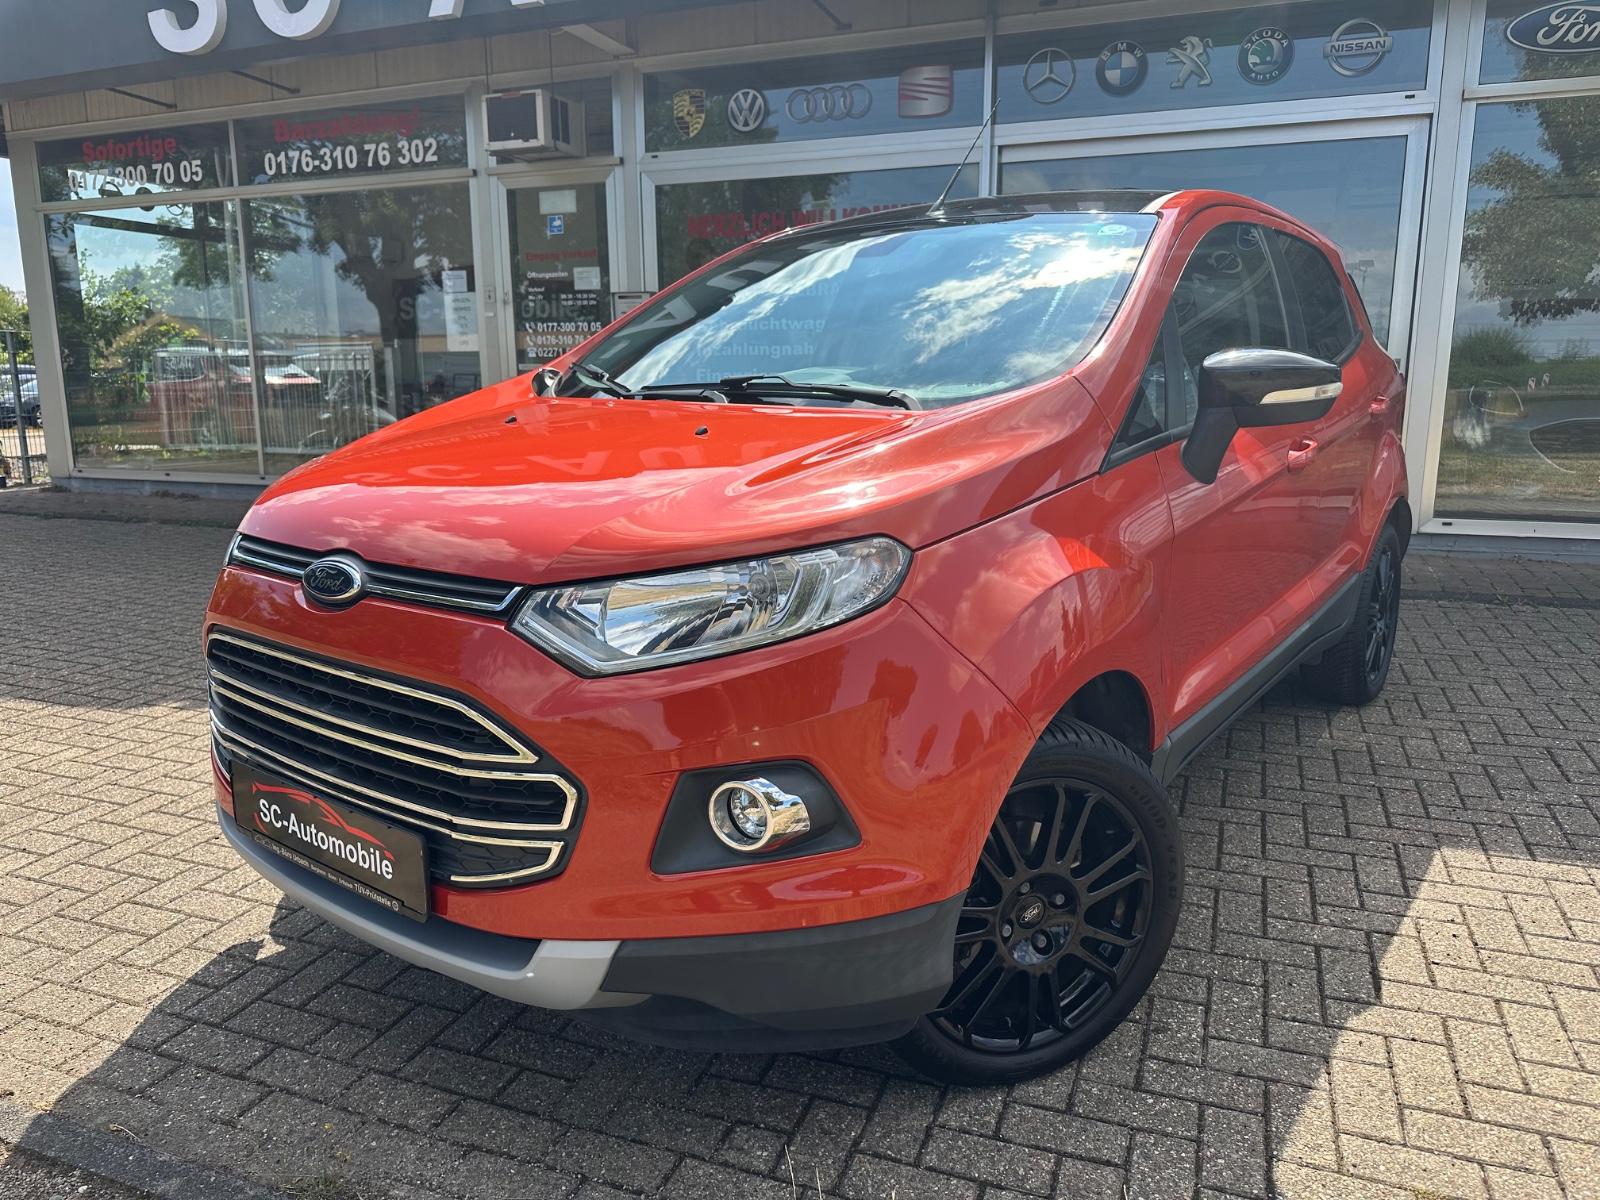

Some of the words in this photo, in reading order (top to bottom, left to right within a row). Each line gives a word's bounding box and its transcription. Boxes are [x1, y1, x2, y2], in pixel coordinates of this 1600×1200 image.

[1101, 42, 1144, 61] BMW
[1330, 39, 1387, 54] NISSAN
[1250, 70, 1279, 81] AUTO
[82, 136, 177, 163] Sofortige
[264, 145, 358, 176] 0176-310
[363, 142, 391, 167] 76
[397, 138, 438, 165] 302
[68, 164, 148, 192] 0177-300
[151, 162, 175, 185] 70
[179, 159, 203, 183] 05
[537, 322, 576, 332] 0177-300
[578, 322, 589, 332] 70
[590, 322, 602, 332] 05
[537, 335, 574, 345] 0176-310
[537, 347, 563, 357] 02271
[311, 566, 345, 591] Ford
[259, 798, 393, 880] SC-Automobile
